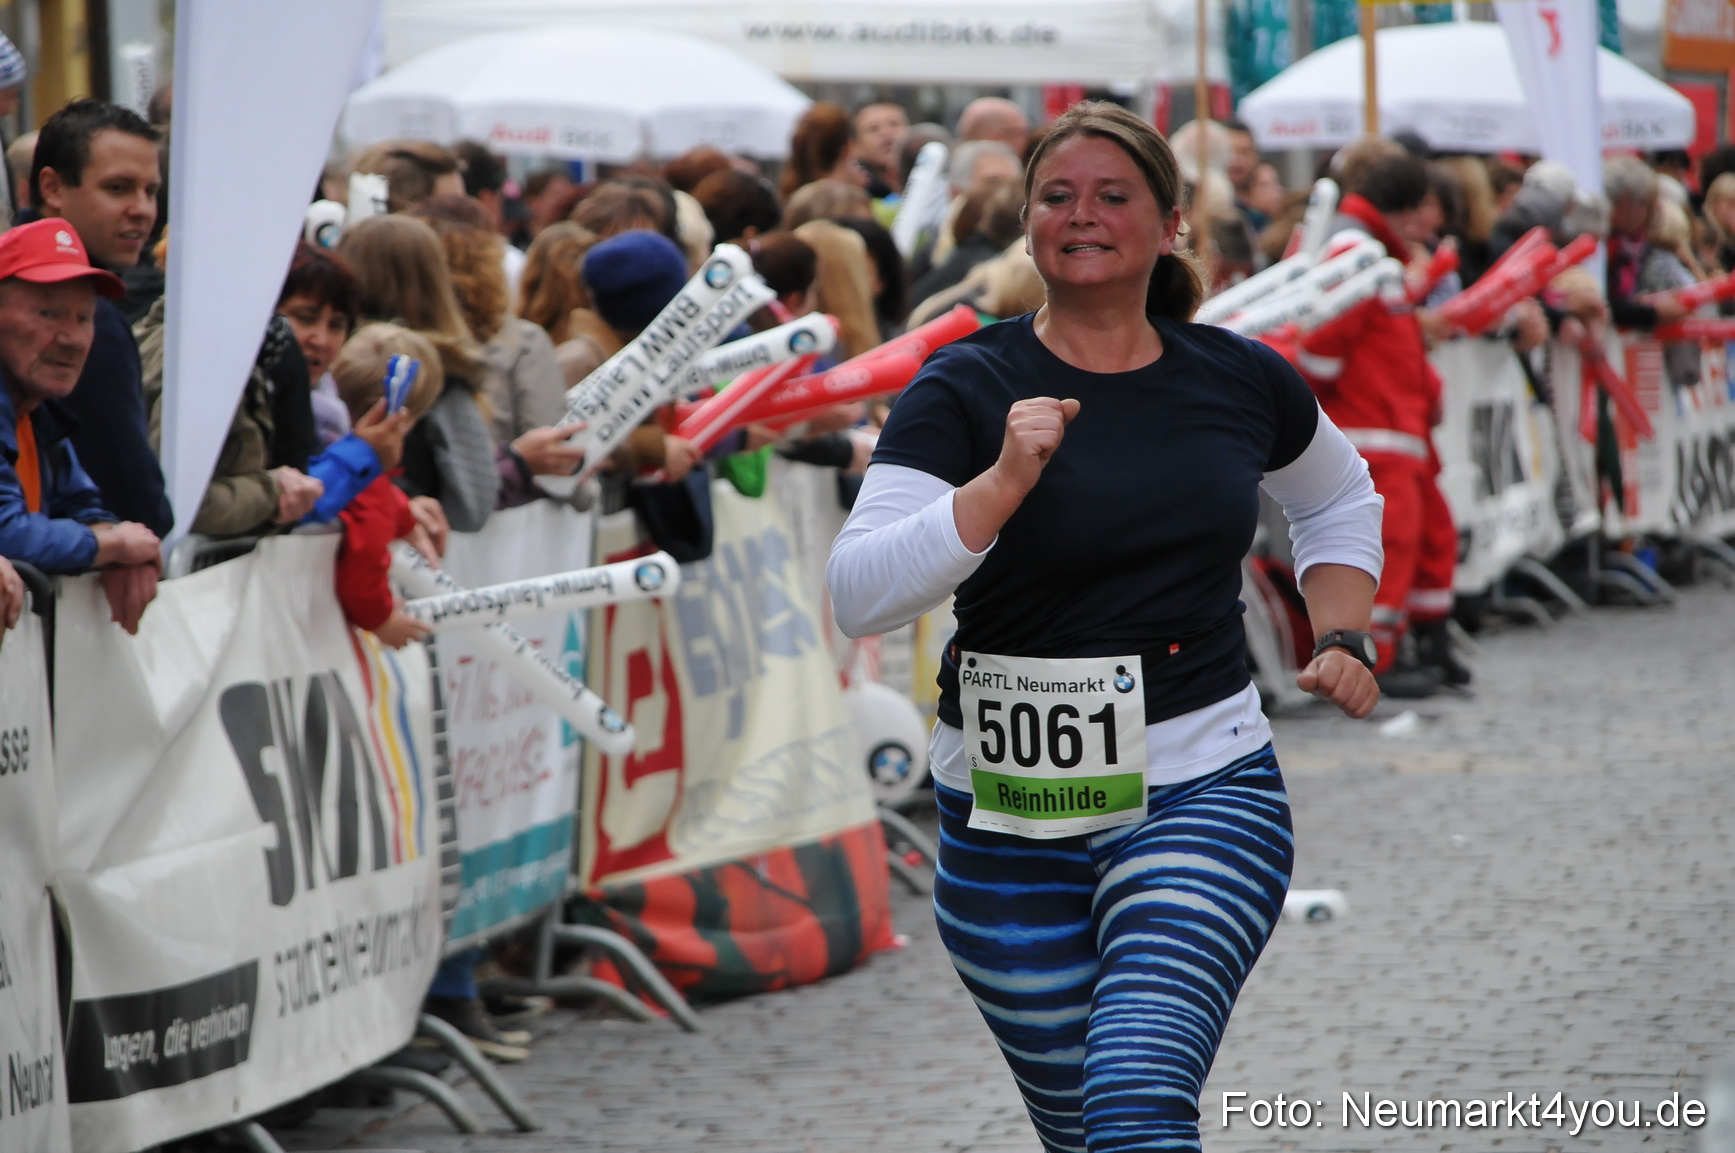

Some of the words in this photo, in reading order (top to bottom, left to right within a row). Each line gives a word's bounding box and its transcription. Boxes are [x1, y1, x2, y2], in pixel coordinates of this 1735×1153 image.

[640, 293, 703, 361] BMW
[963, 670, 1012, 691] PARTL
[1018, 676, 1106, 692] Neumarkt
[978, 698, 1118, 769] 5061
[997, 782, 1107, 812] Reinhilde
